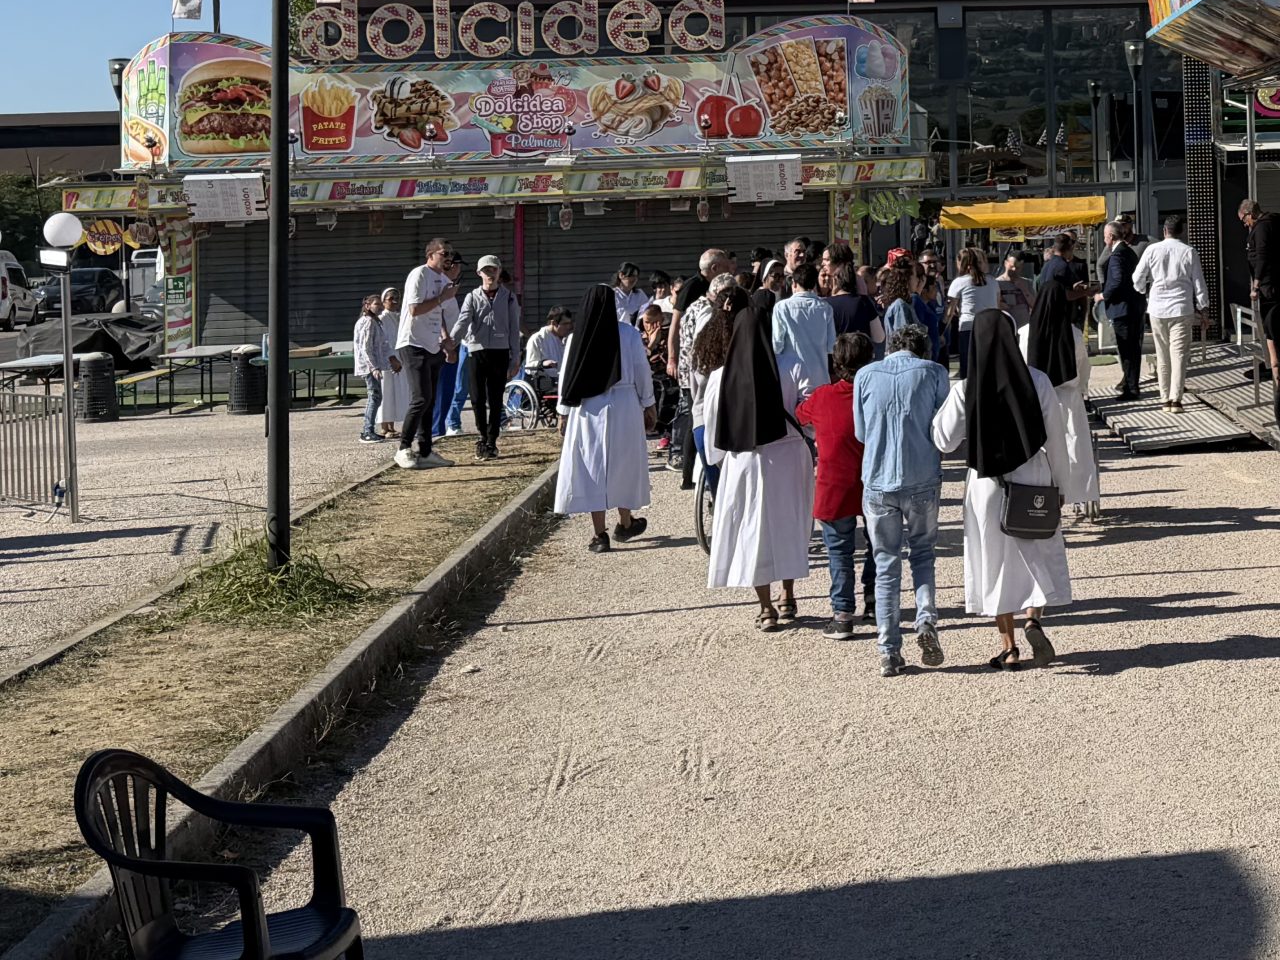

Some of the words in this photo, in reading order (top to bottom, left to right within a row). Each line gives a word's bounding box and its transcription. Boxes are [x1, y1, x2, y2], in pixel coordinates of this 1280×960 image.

[475, 94, 565, 117] Dolcidea
[312, 121, 346, 131] PATATE
[518, 113, 563, 134] Shop
[312, 135, 347, 145] FRITTE
[506, 134, 562, 148] Palmieri
